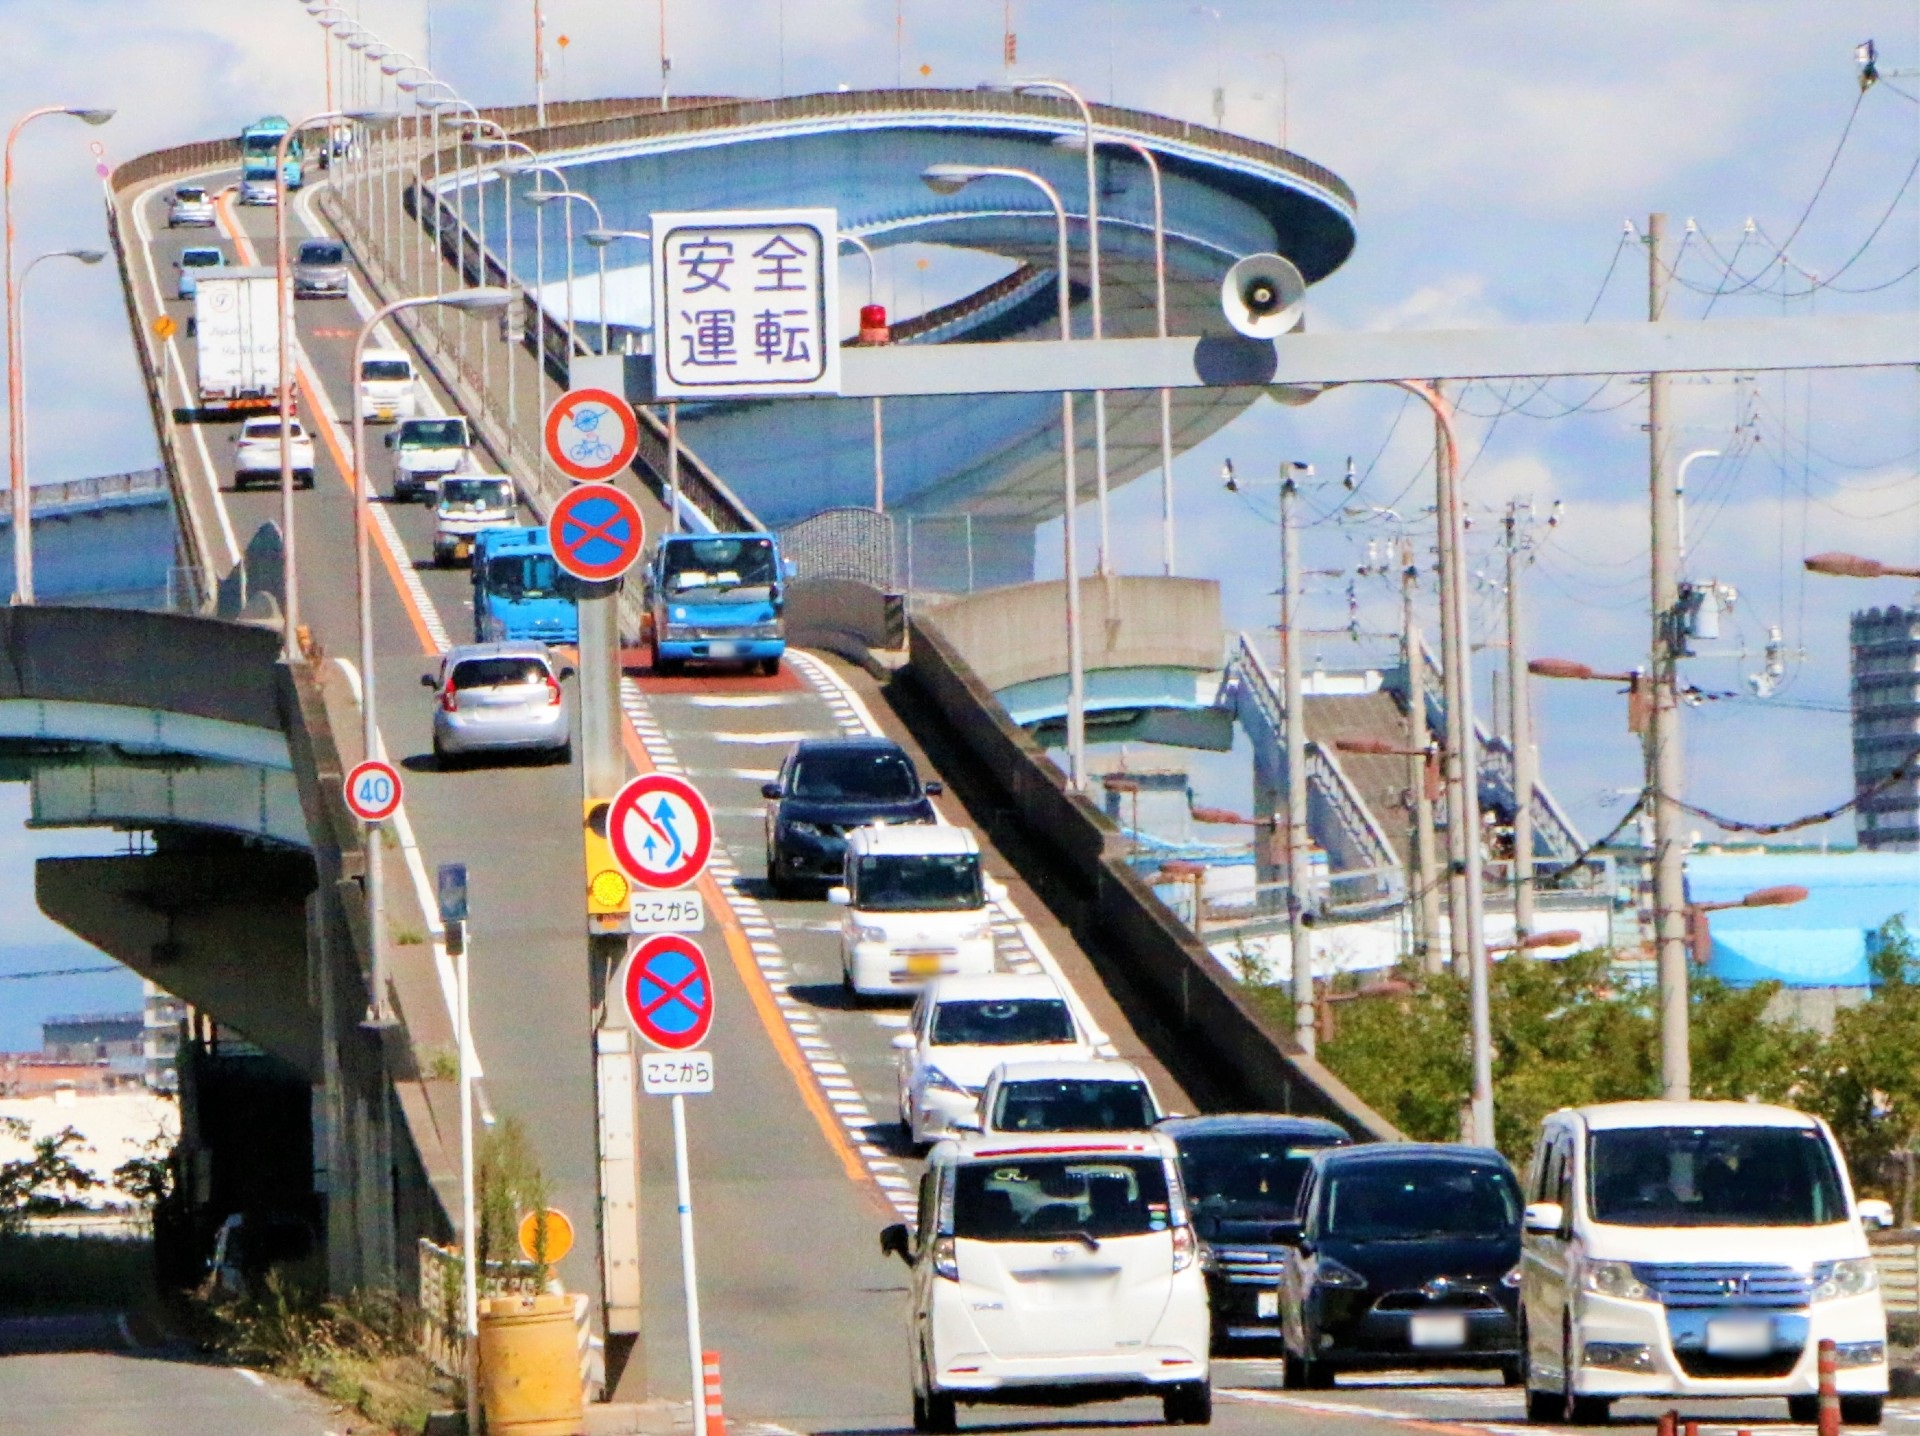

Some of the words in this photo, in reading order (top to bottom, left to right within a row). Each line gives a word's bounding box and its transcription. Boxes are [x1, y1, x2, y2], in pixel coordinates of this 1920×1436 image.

[677, 234, 808, 294] 安全
[680, 308, 811, 367] 運転
[360, 777, 390, 803] 40
[634, 901, 699, 923] ここから
[648, 1062, 709, 1084] ここから
